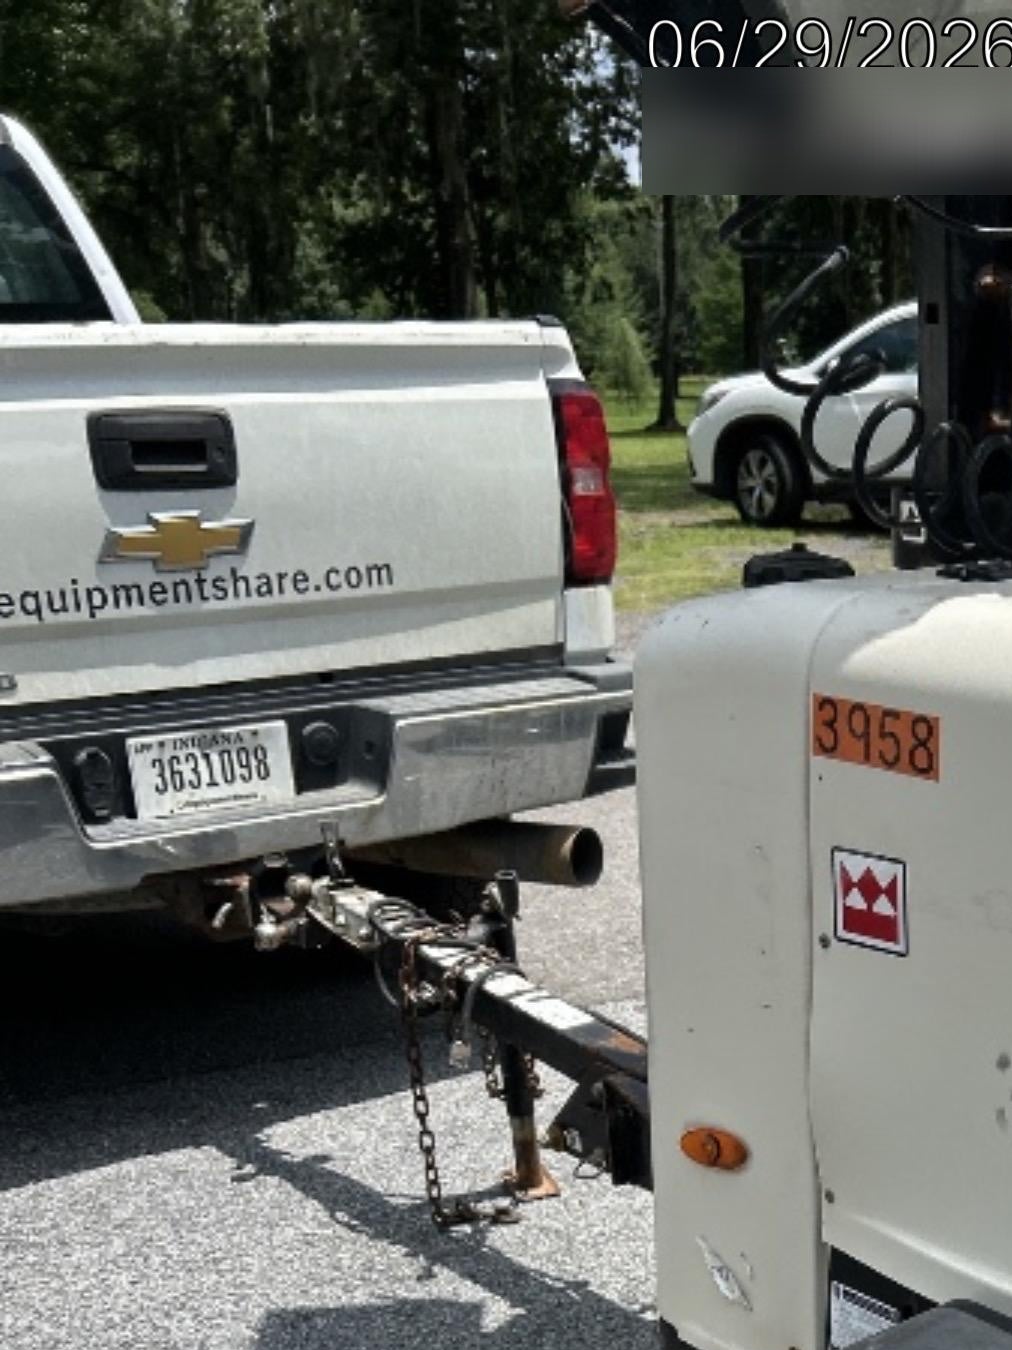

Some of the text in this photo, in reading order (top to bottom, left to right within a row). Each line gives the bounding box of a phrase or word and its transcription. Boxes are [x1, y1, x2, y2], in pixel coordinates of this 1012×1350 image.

[0, 561, 394, 621] equipmentshare.com
[816, 697, 934, 774] 3958
[152, 744, 270, 795] 3631098
